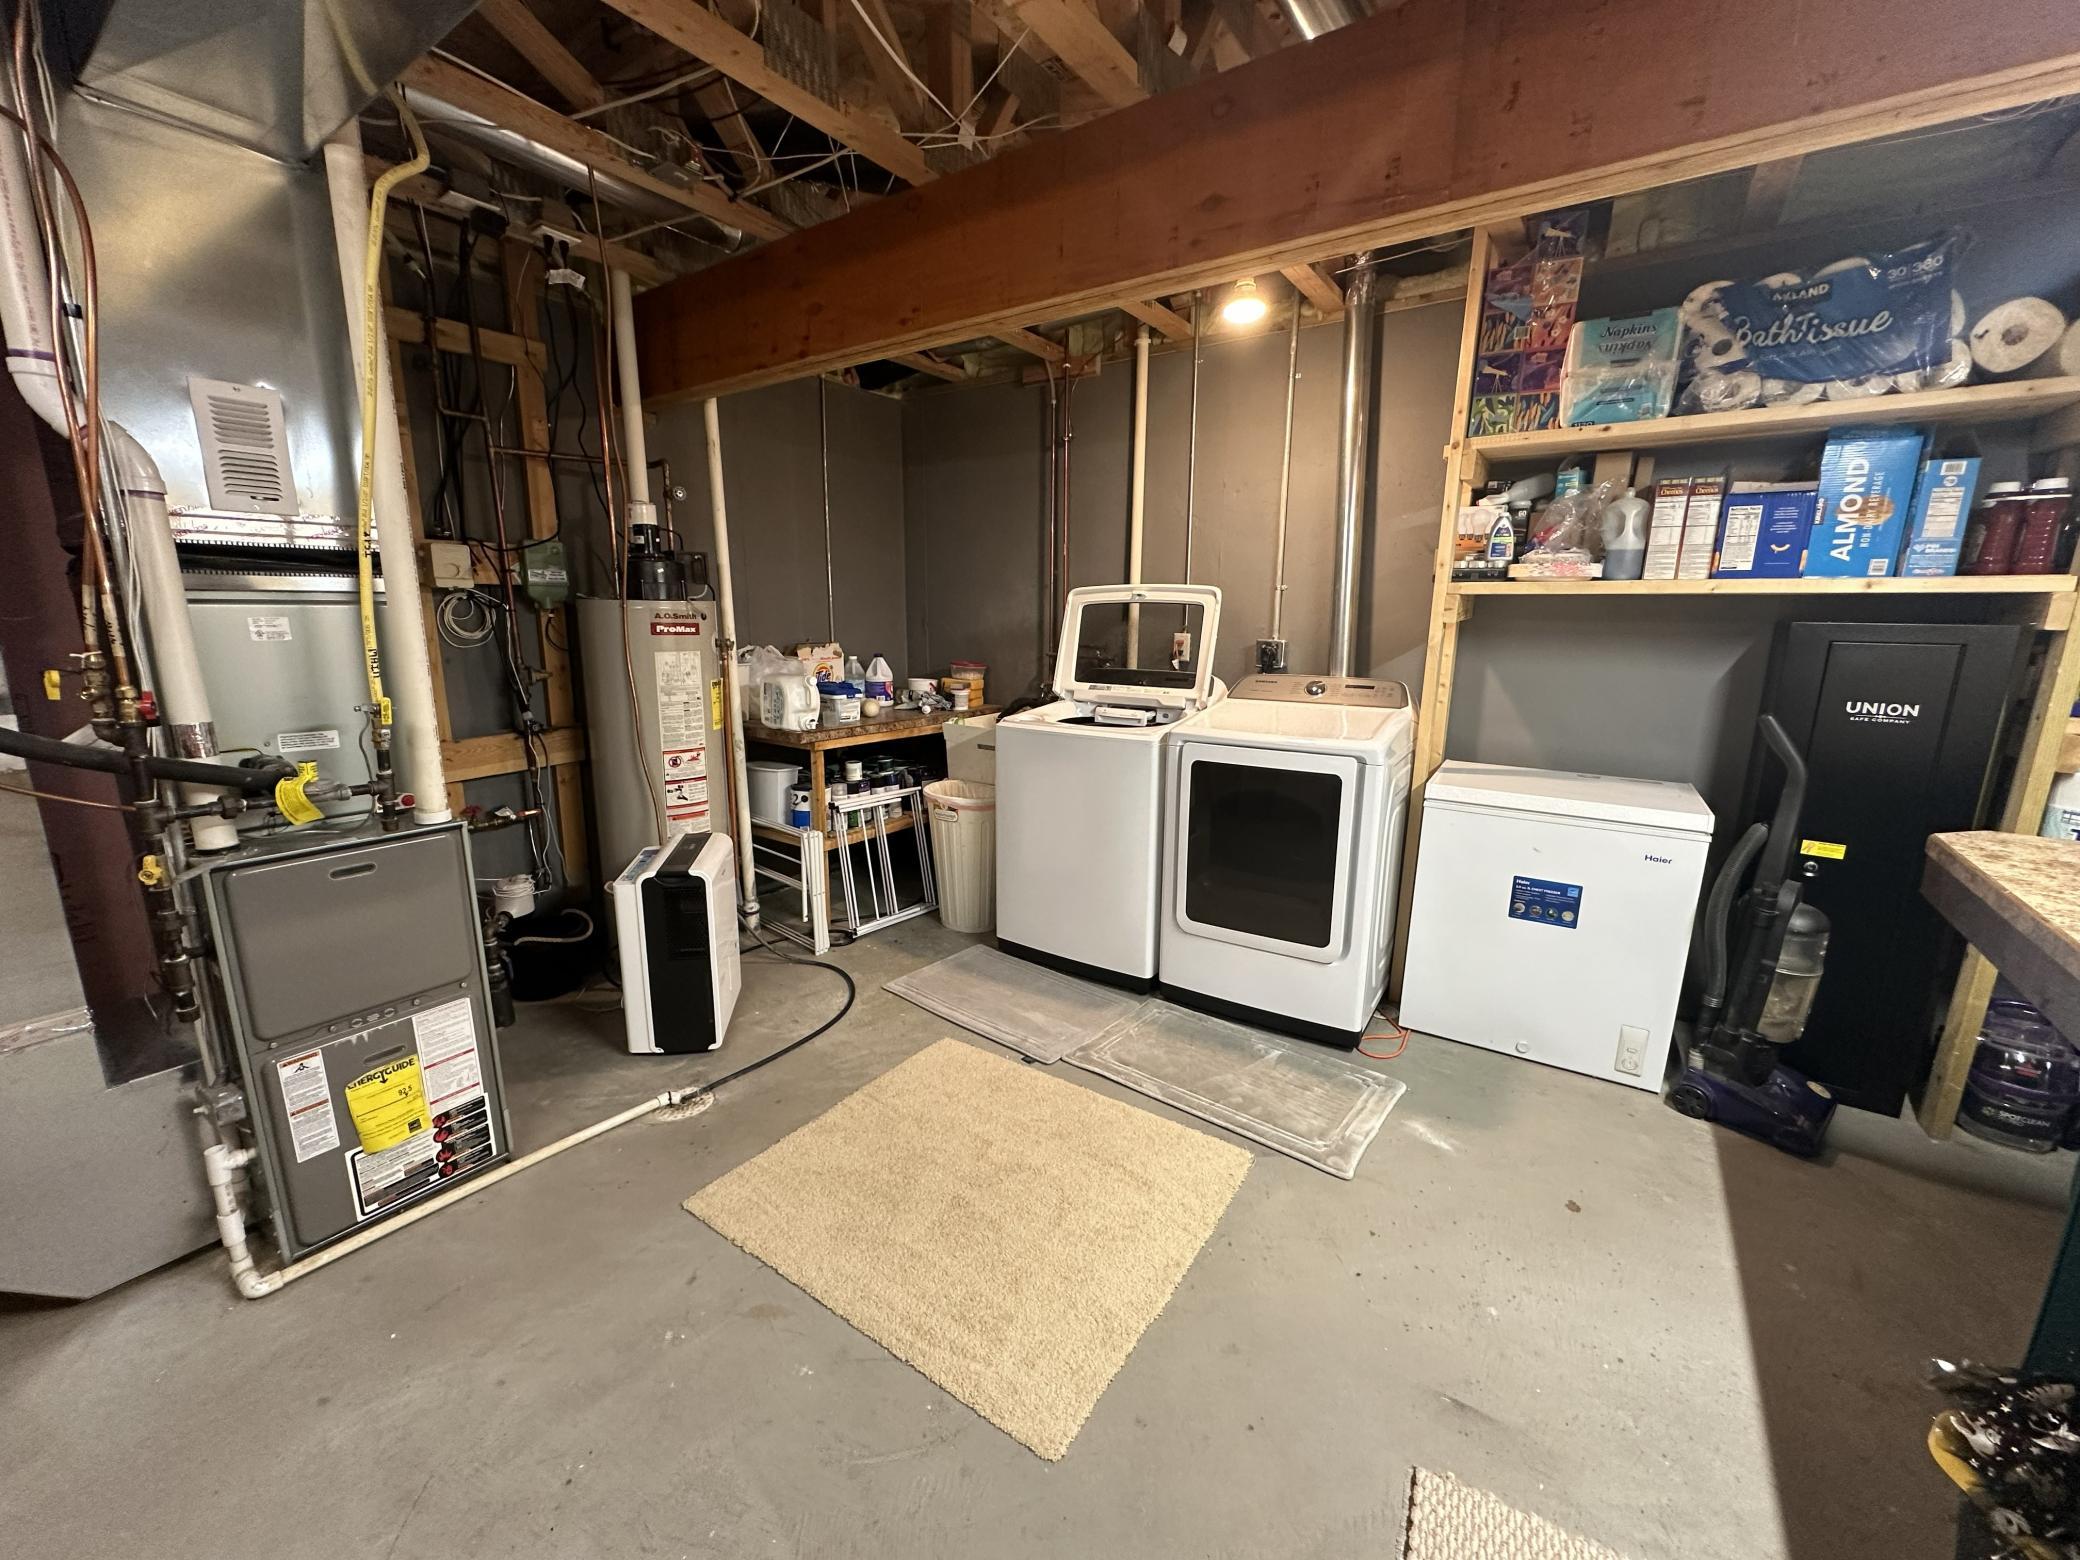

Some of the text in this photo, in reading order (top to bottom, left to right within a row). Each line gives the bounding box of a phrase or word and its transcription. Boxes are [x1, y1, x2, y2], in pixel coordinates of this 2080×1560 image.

[1600, 323, 1658, 339] Napkins
[1734, 310, 1894, 348] Bath Tissue
[1829, 457, 1871, 562] ALMOND
[656, 625, 696, 633] ProMax
[815, 670, 832, 682] Tide
[1845, 701, 1920, 717] UNION
[1871, 717, 1910, 725] COMPANY
[1644, 853, 1673, 865] Haier
